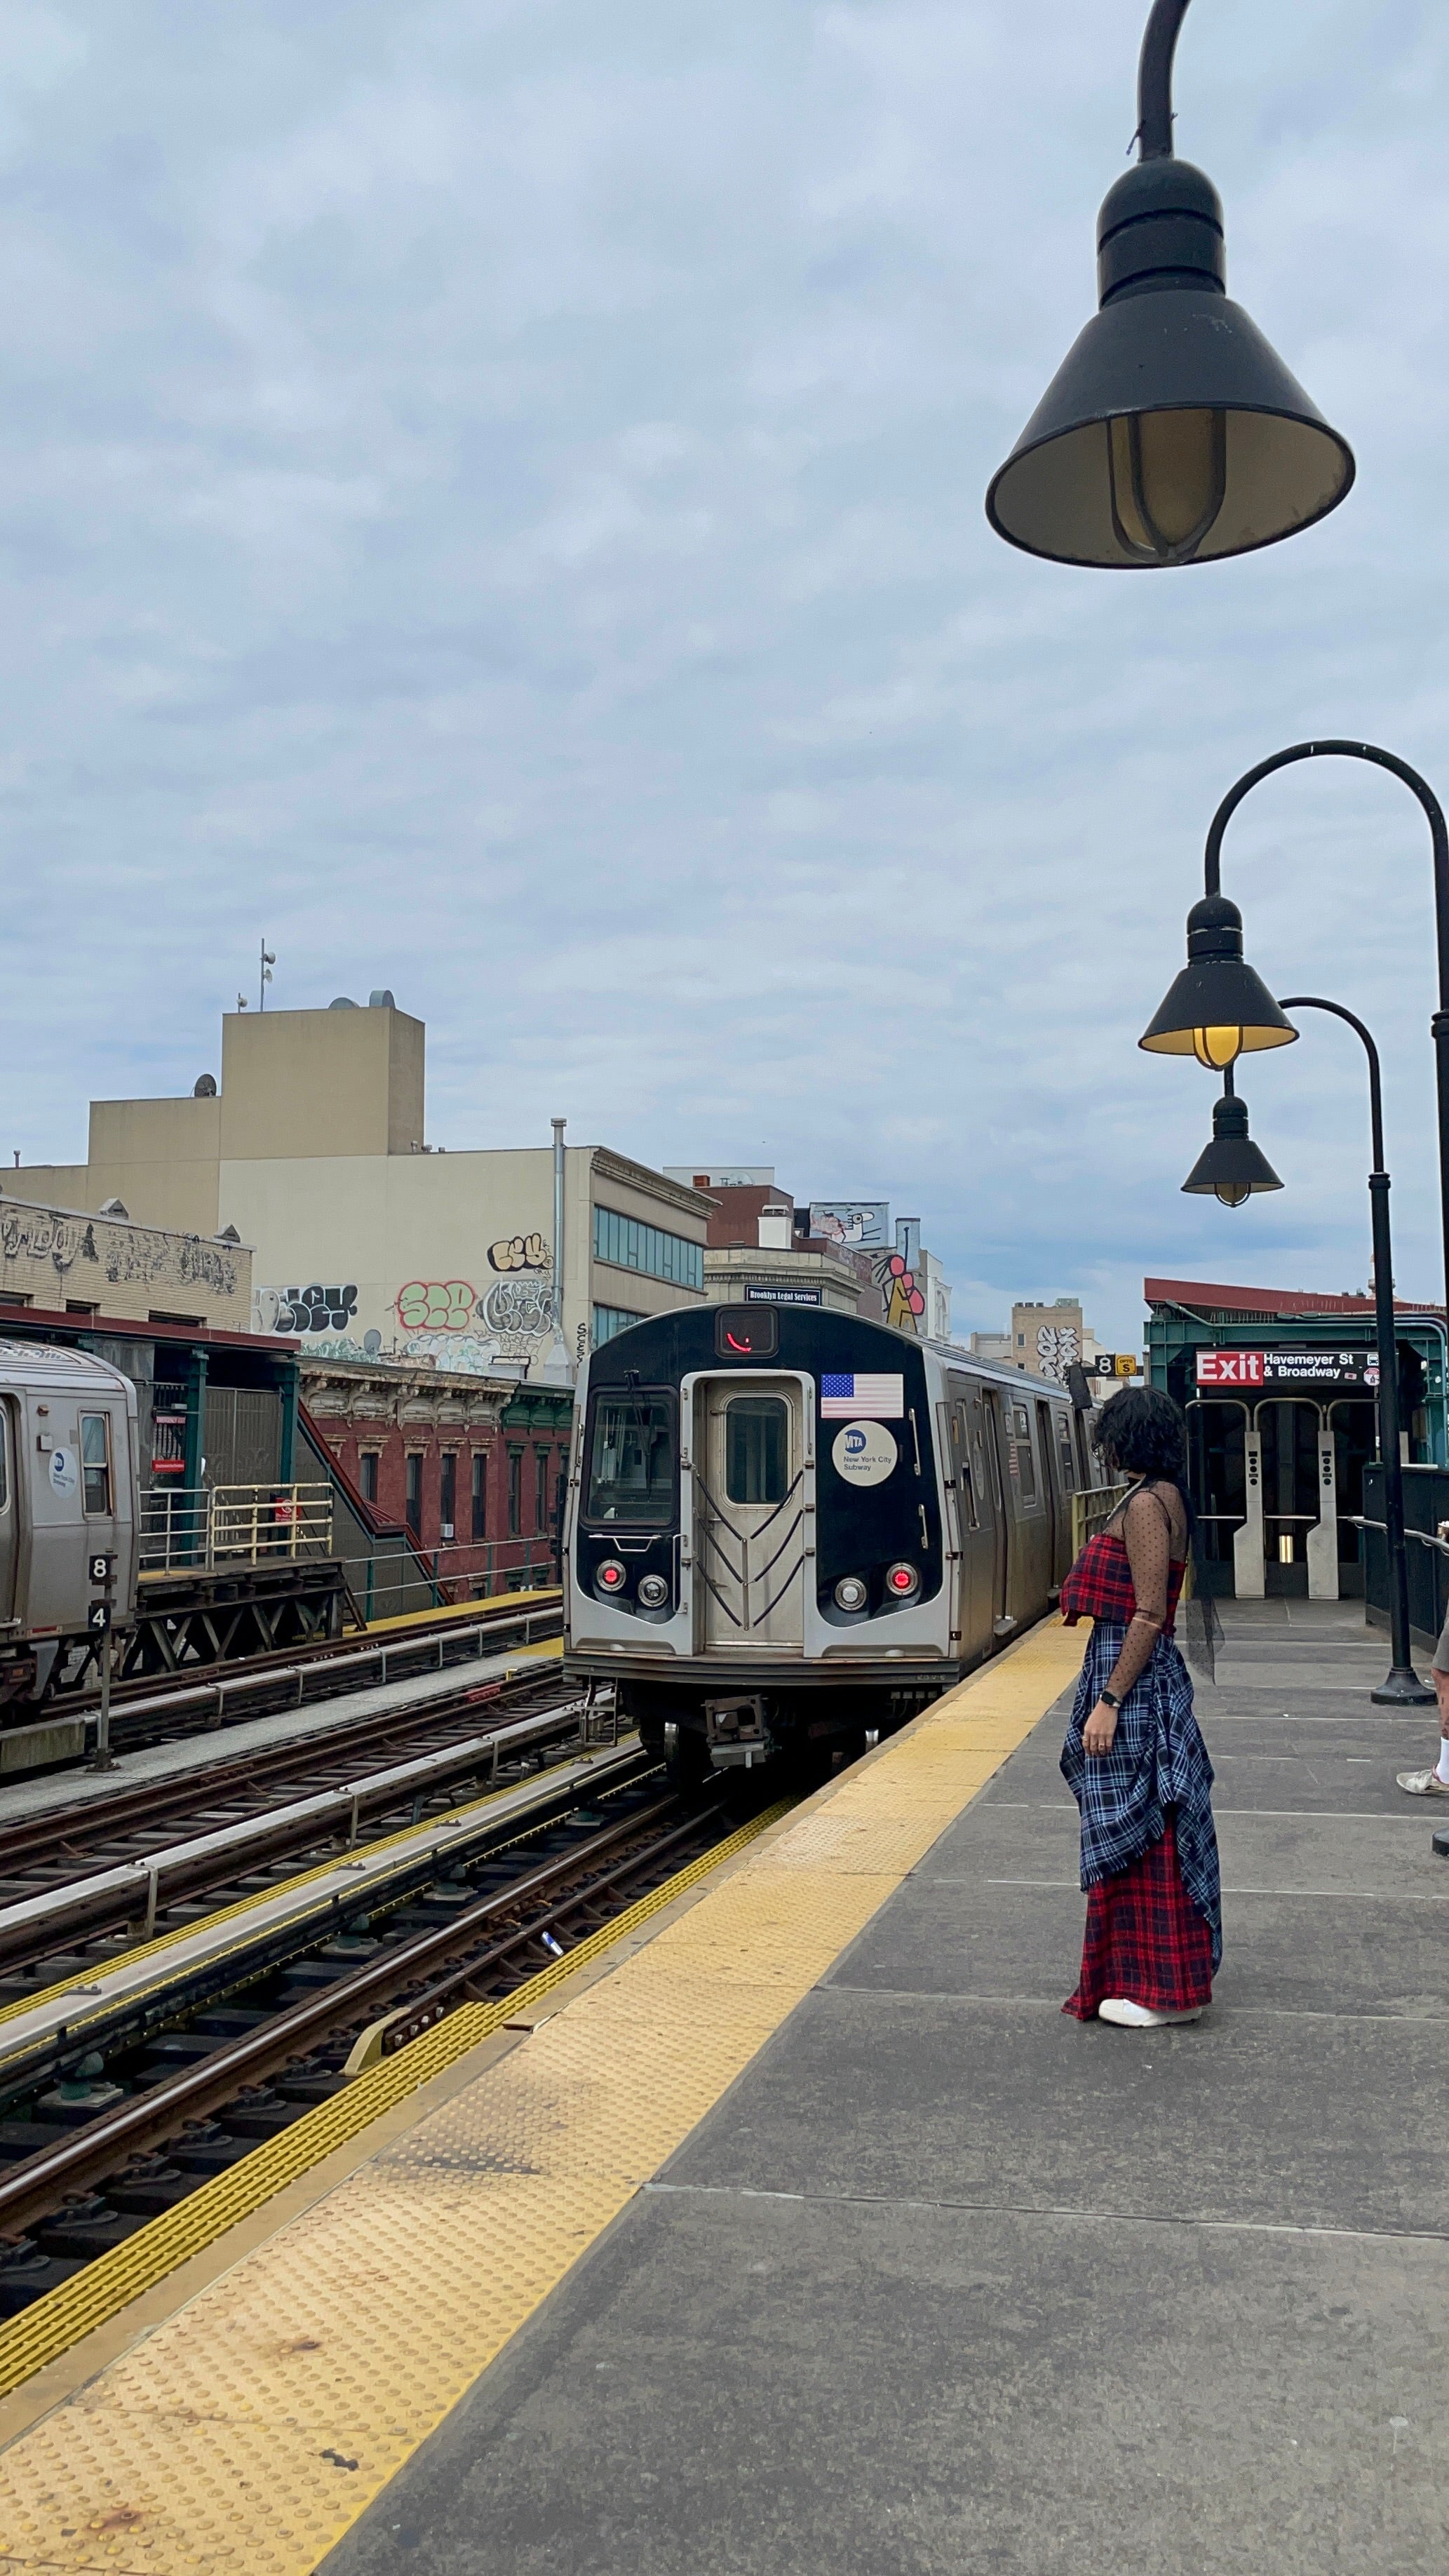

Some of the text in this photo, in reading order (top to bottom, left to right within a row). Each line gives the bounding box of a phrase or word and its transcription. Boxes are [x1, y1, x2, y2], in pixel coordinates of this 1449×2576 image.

[750, 1291, 817, 1301] Brooklyn Legal Services
[1099, 1357, 1112, 1373] 8
[1263, 1353, 1354, 1365] Havemeyer St
[1122, 1364, 1130, 1372] S
[1197, 1354, 1260, 1380] Exit
[1263, 1366, 1341, 1378] & Broadway
[844, 1435, 863, 1449] MTA
[93, 1559, 107, 1578] 8
[93, 1608, 106, 1627] 4
